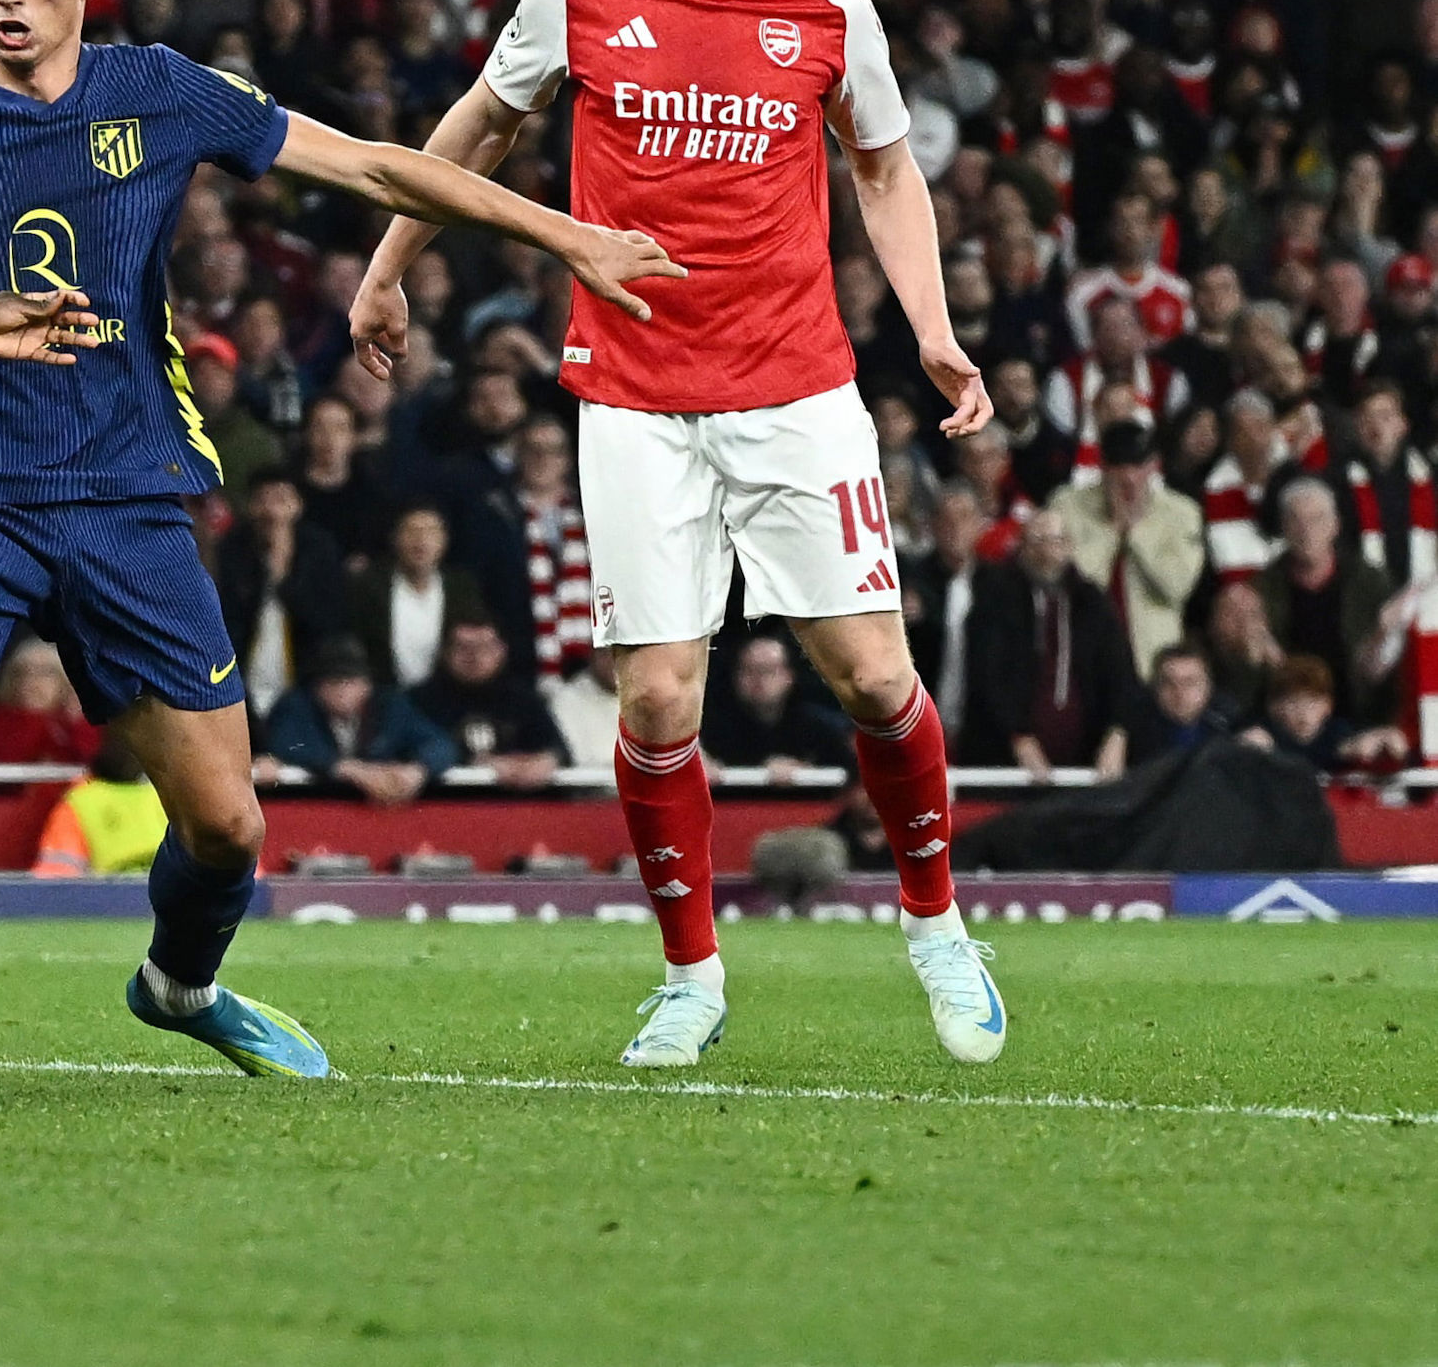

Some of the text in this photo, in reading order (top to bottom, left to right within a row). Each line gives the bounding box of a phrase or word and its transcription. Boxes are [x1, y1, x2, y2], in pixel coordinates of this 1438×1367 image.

[612, 80, 798, 132] Emirates
[637, 126, 770, 164] FLY BETTER
[828, 476, 890, 555] 14
